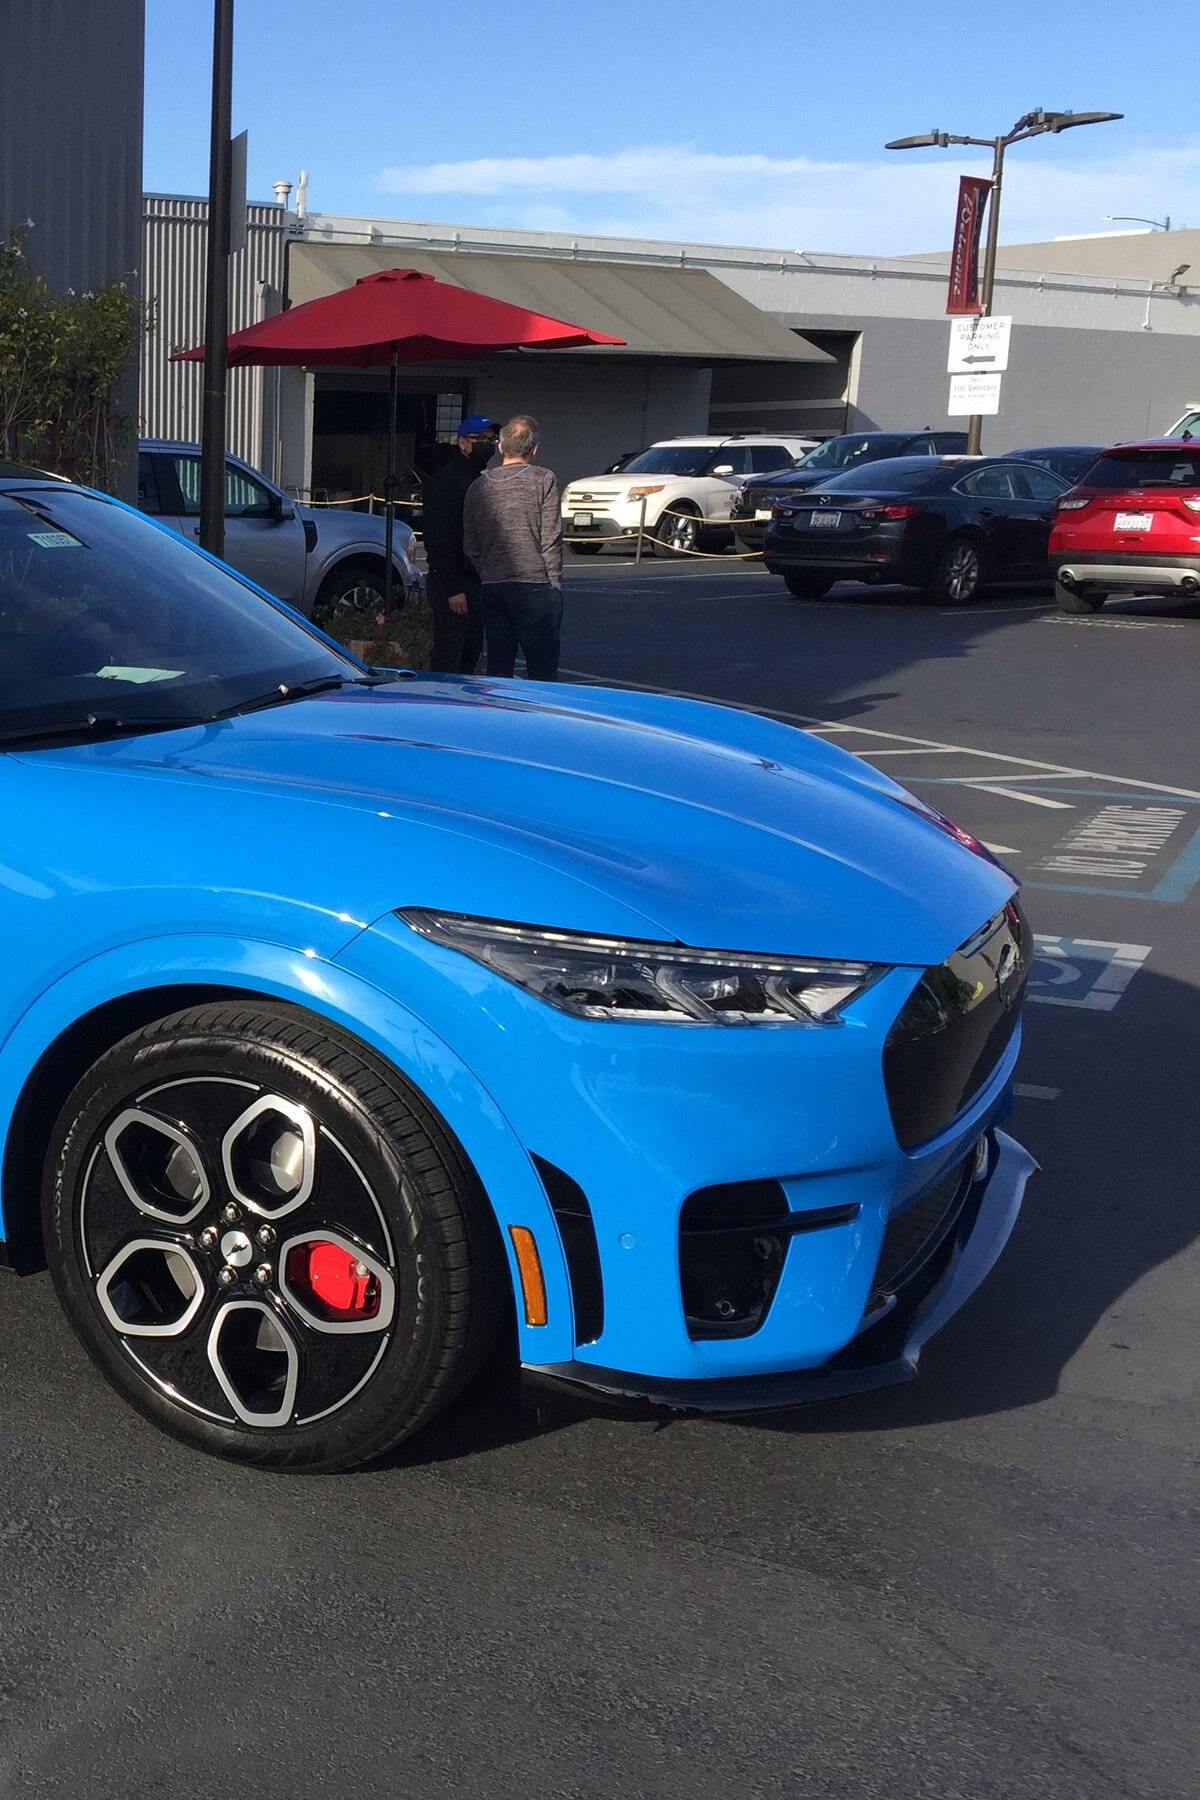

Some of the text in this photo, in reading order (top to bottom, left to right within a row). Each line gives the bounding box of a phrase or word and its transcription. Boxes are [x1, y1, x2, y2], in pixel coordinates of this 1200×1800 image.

[956, 322, 1006, 332] CUSTOMER
[960, 331, 1000, 341] PARKING
[1027, 805, 1187, 879] NO PARKING
